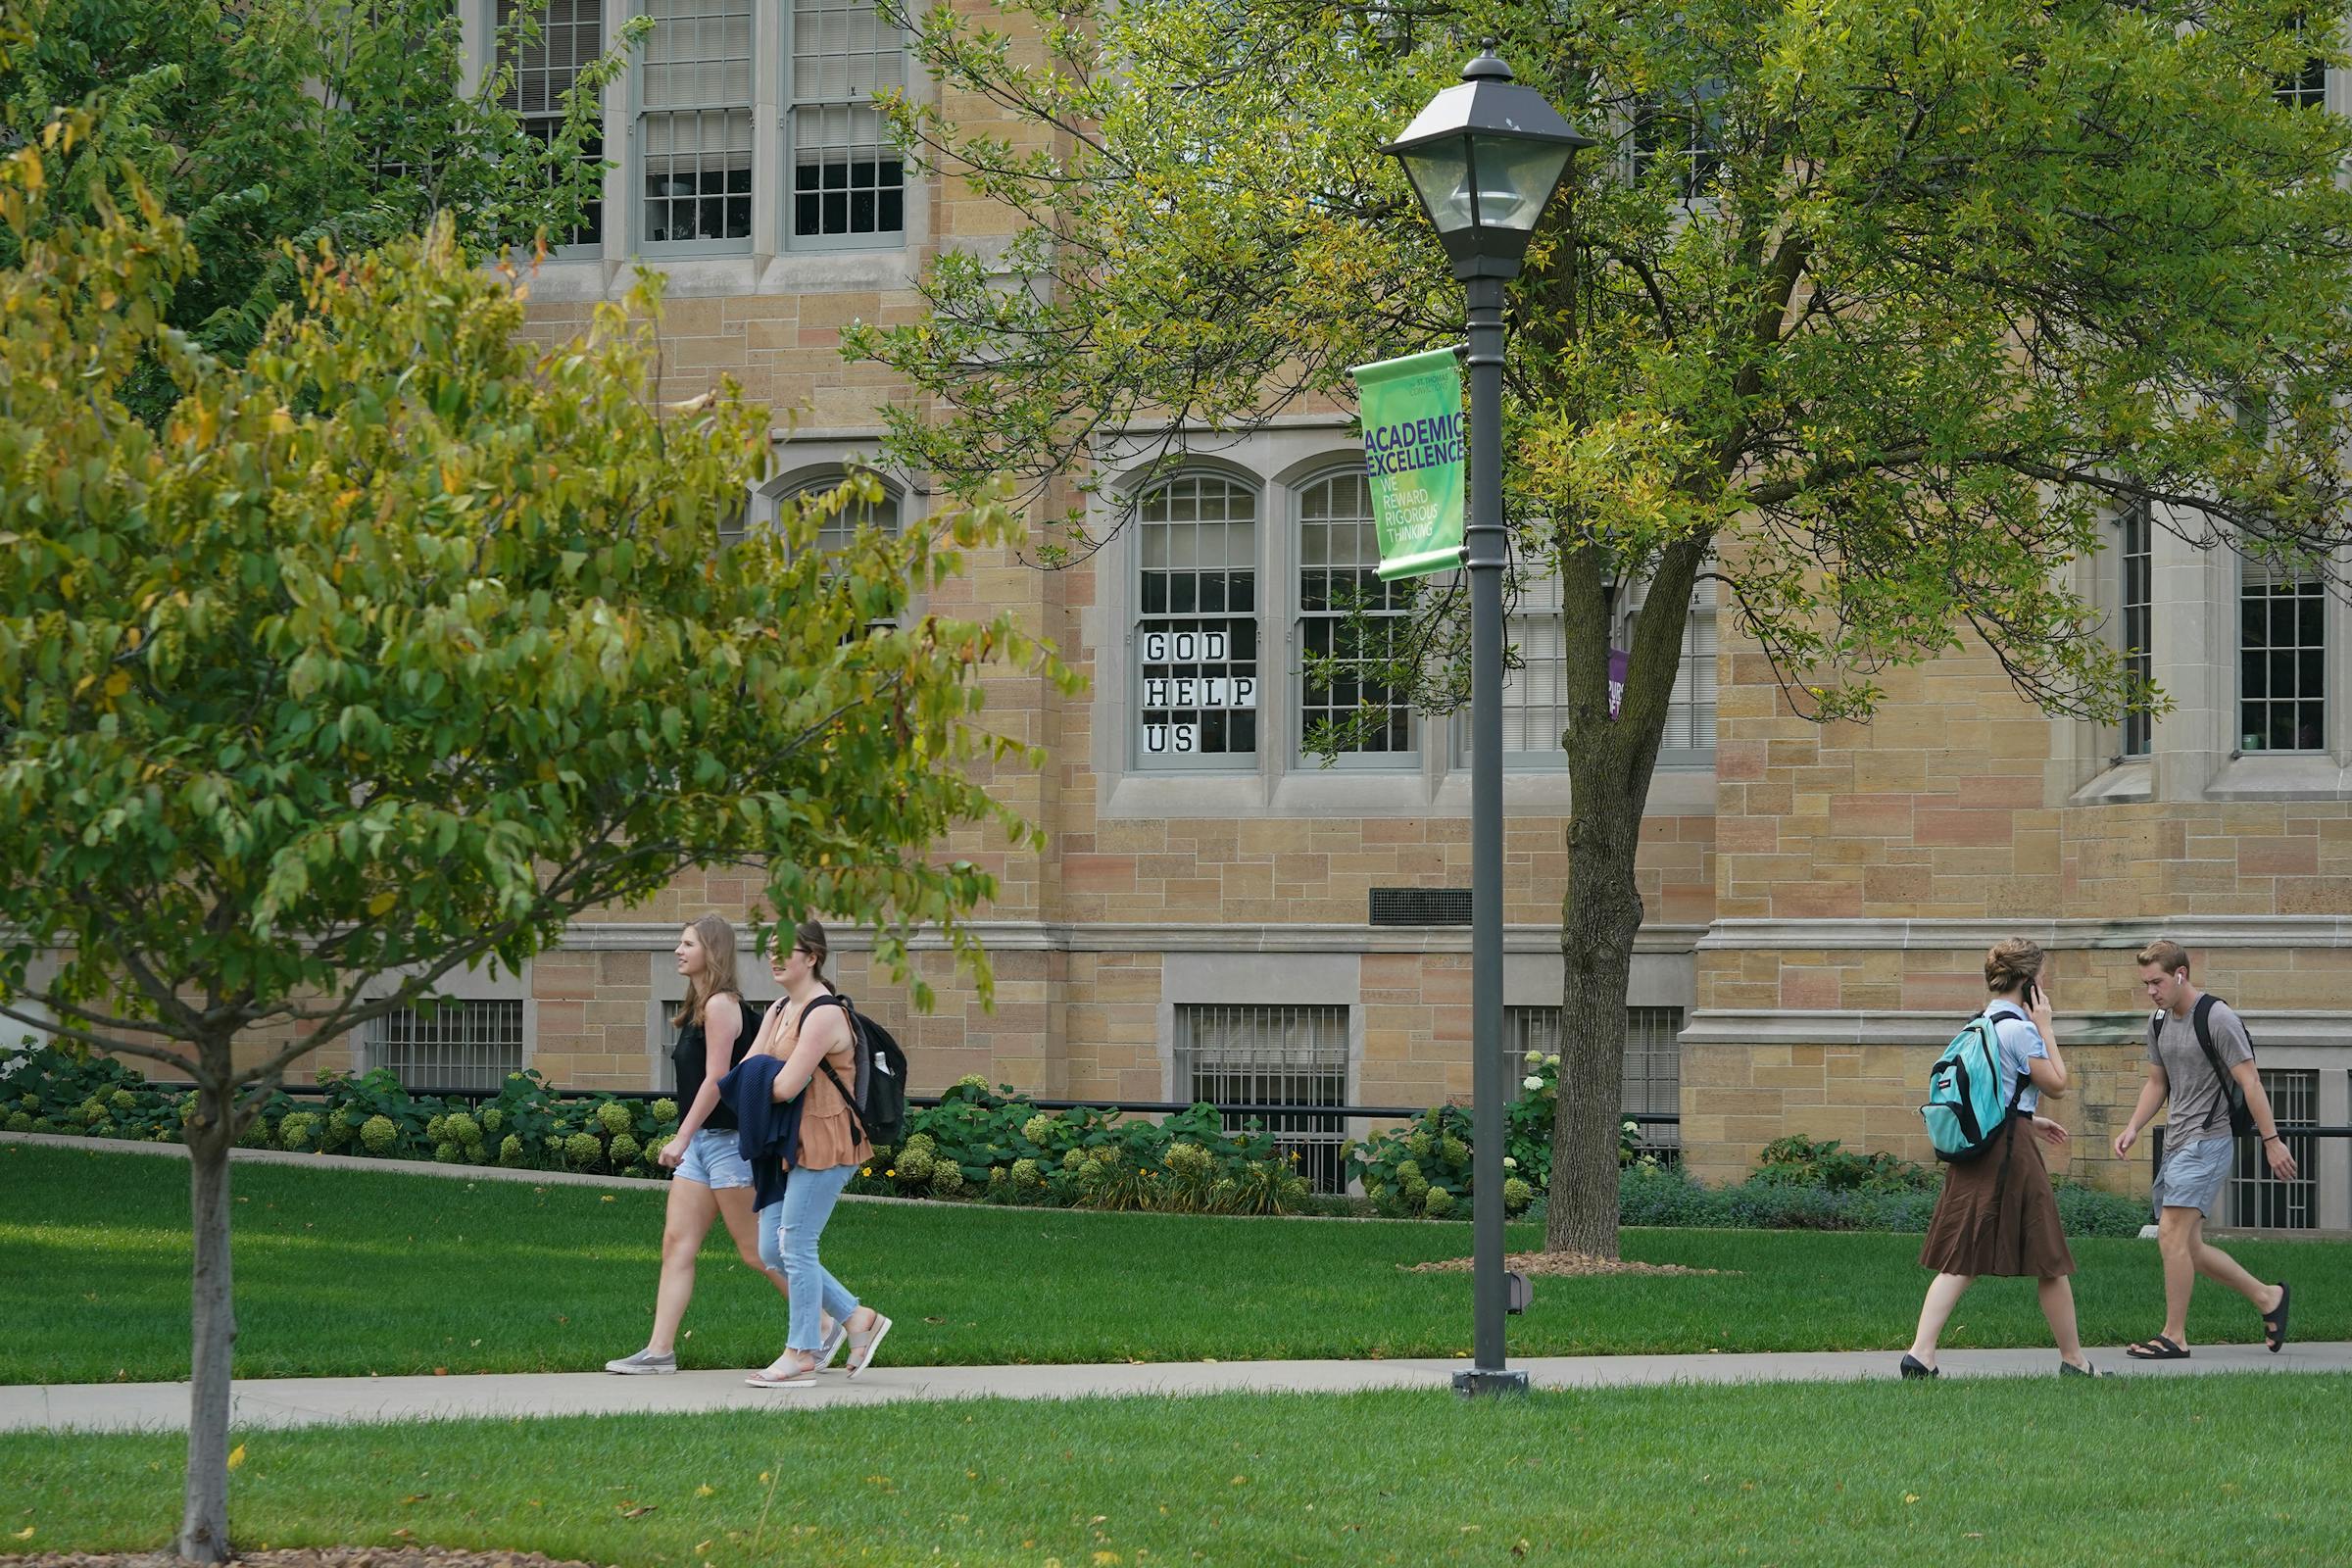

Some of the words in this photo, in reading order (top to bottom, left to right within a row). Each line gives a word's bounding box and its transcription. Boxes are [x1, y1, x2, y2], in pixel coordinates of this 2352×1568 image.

[1365, 412, 1464, 453] ACADEMIC
[1364, 439, 1464, 477] EXCELLENCE
[1380, 476, 1397, 492] WE
[1383, 488, 1428, 510] REWARD
[1385, 504, 1438, 526] RIGOROUS
[1387, 522, 1433, 543] THINKING
[1148, 633, 1225, 661] GOD
[1148, 679, 1252, 707] HELP
[1148, 725, 1192, 752] US
